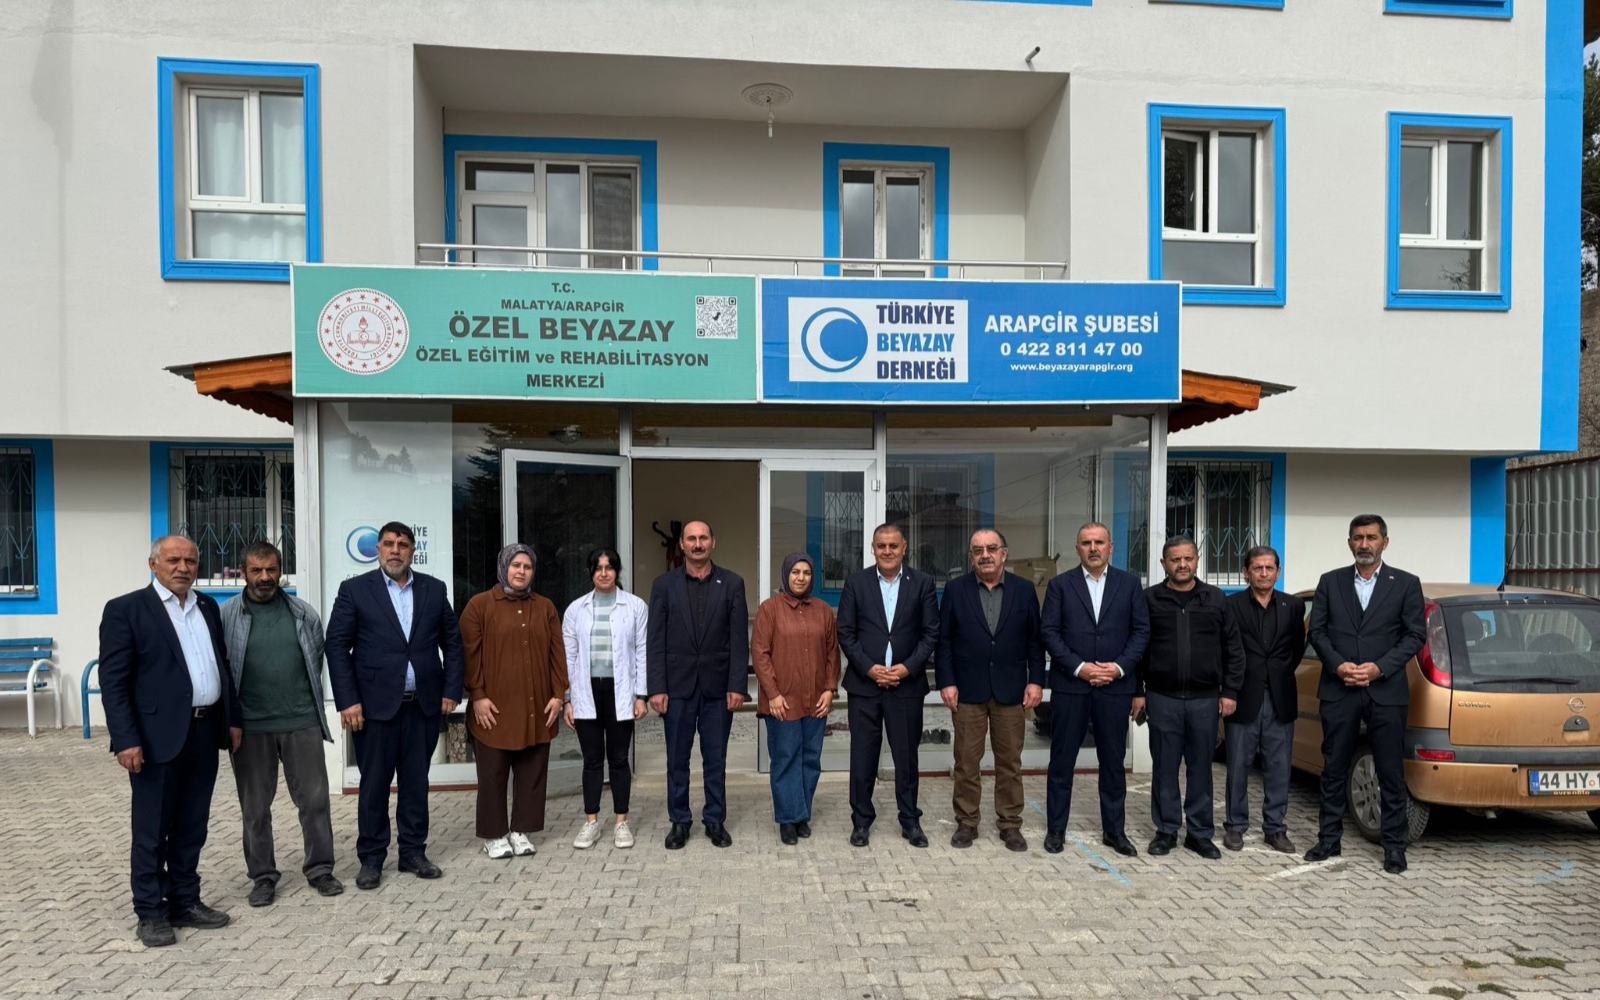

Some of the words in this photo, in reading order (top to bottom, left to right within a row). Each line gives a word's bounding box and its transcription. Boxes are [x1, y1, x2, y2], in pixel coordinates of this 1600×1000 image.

[551, 282, 576, 294] T.C.
[500, 299, 625, 313] MALATYA/ARAPGİR
[876, 301, 955, 325] TÜRKİYE
[449, 311, 529, 339] ÖZEL
[539, 317, 675, 342] BEYAZAY
[984, 311, 1078, 334] ARAPGİR
[1084, 312, 1159, 338] ŞUBESİ
[876, 332, 955, 353] BEYAZAY
[1000, 342, 1012, 357] 0
[1016, 342, 1050, 357] 422
[1055, 342, 1087, 357] 811
[1093, 342, 1116, 357] 47
[1120, 342, 1143, 357] 00
[415, 345, 463, 363] ÖZEL
[468, 345, 530, 364] EĞİTİM
[536, 353, 555, 364] ve
[560, 348, 709, 367] REHABİLİTASYON
[876, 357, 956, 380] DERNEĞİ
[1009, 362, 1134, 373] www.beyazayarapgir.org
[526, 373, 605, 389] MERKEZİ
[1540, 772, 1560, 789] 44
[1566, 772, 1588, 789] HY
